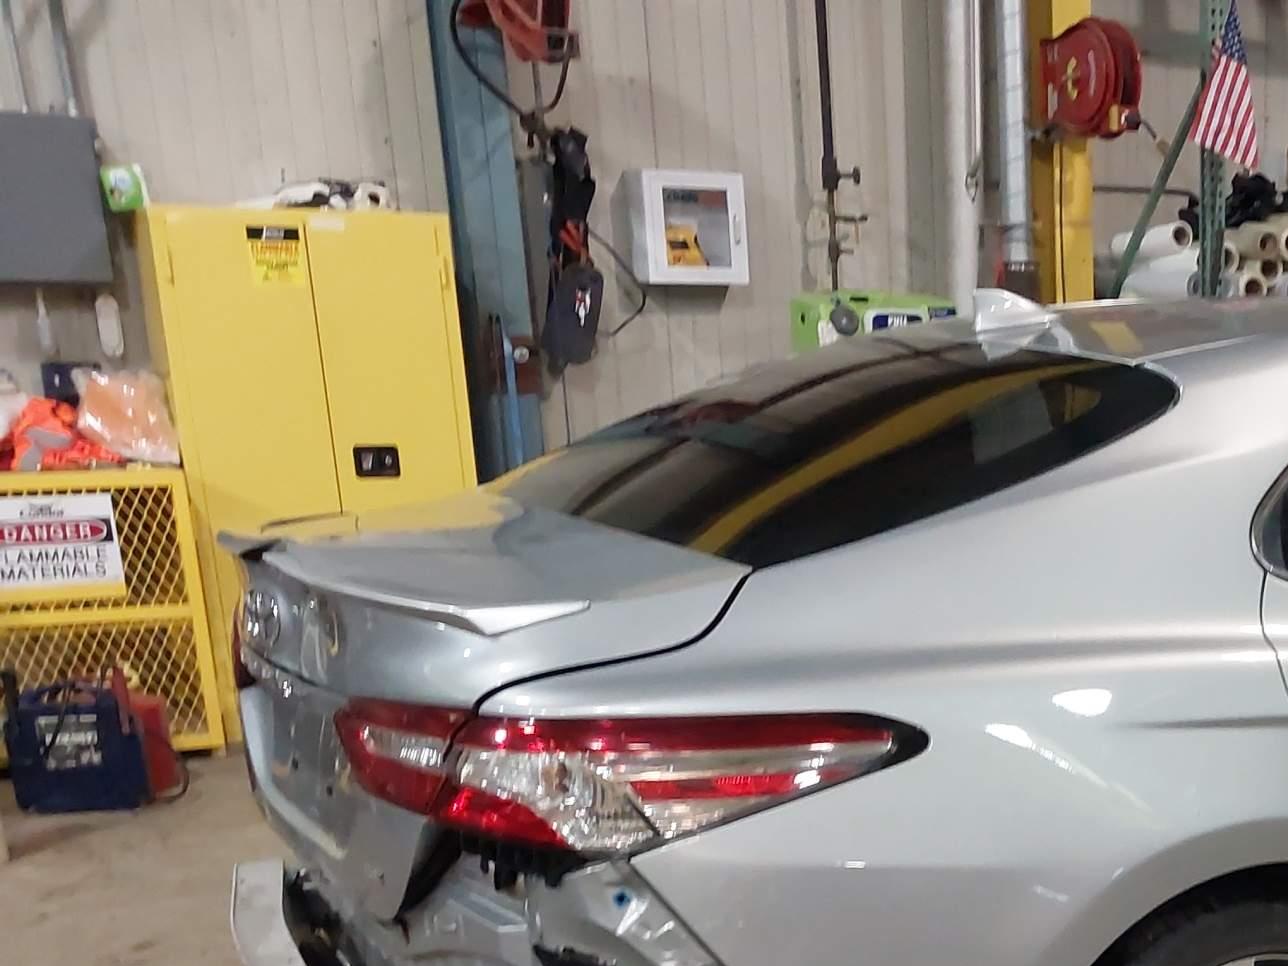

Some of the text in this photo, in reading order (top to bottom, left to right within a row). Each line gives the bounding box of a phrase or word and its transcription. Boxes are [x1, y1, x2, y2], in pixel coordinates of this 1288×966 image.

[3, 521, 91, 542] DANGER
[0, 543, 107, 565] LAMMABLE
[0, 561, 107, 581] MATERIALS
